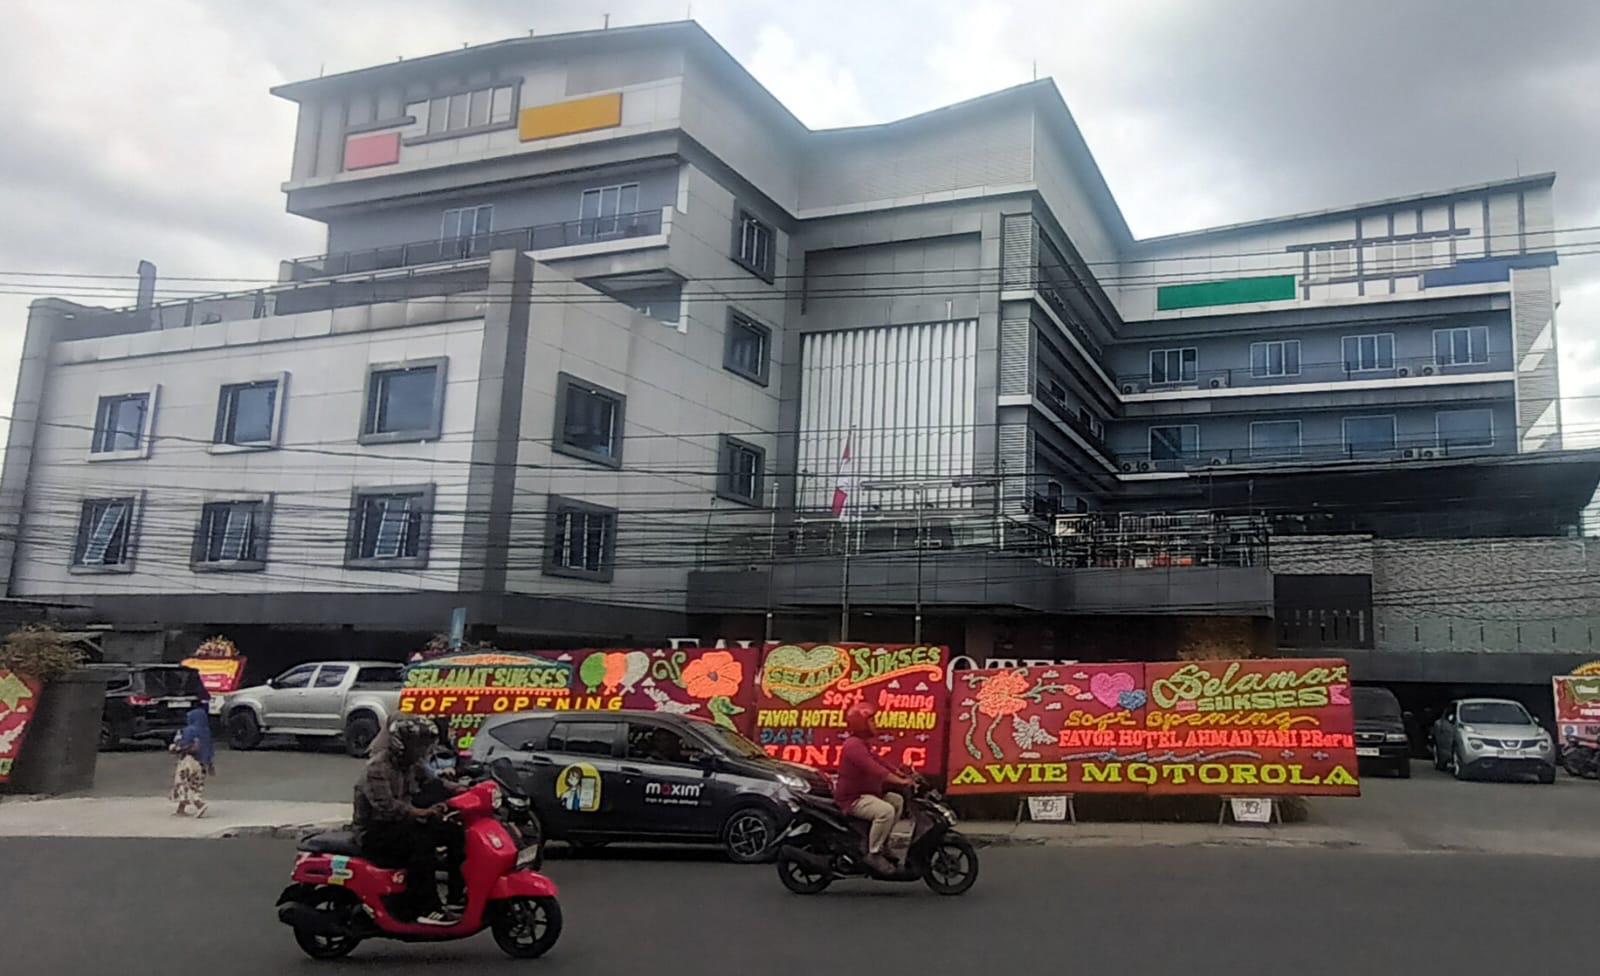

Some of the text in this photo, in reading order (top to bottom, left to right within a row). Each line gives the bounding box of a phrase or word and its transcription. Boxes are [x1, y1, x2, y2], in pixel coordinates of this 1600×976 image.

[851, 647, 941, 682] SUKSES
[404, 668, 569, 688] SELAMAT SUKSES
[1152, 662, 1348, 708] Selamat
[401, 696, 624, 712] SOFT OPENING
[1198, 687, 1329, 712] SUKSES
[757, 709, 799, 727] FAVOR
[801, 710, 848, 727] HOTEL
[1059, 730, 1117, 747] FAVOR
[1118, 730, 1183, 749] HOTEL
[1184, 730, 1254, 747] AHMAD
[952, 763, 1360, 786] AWIE MOTOROLA
